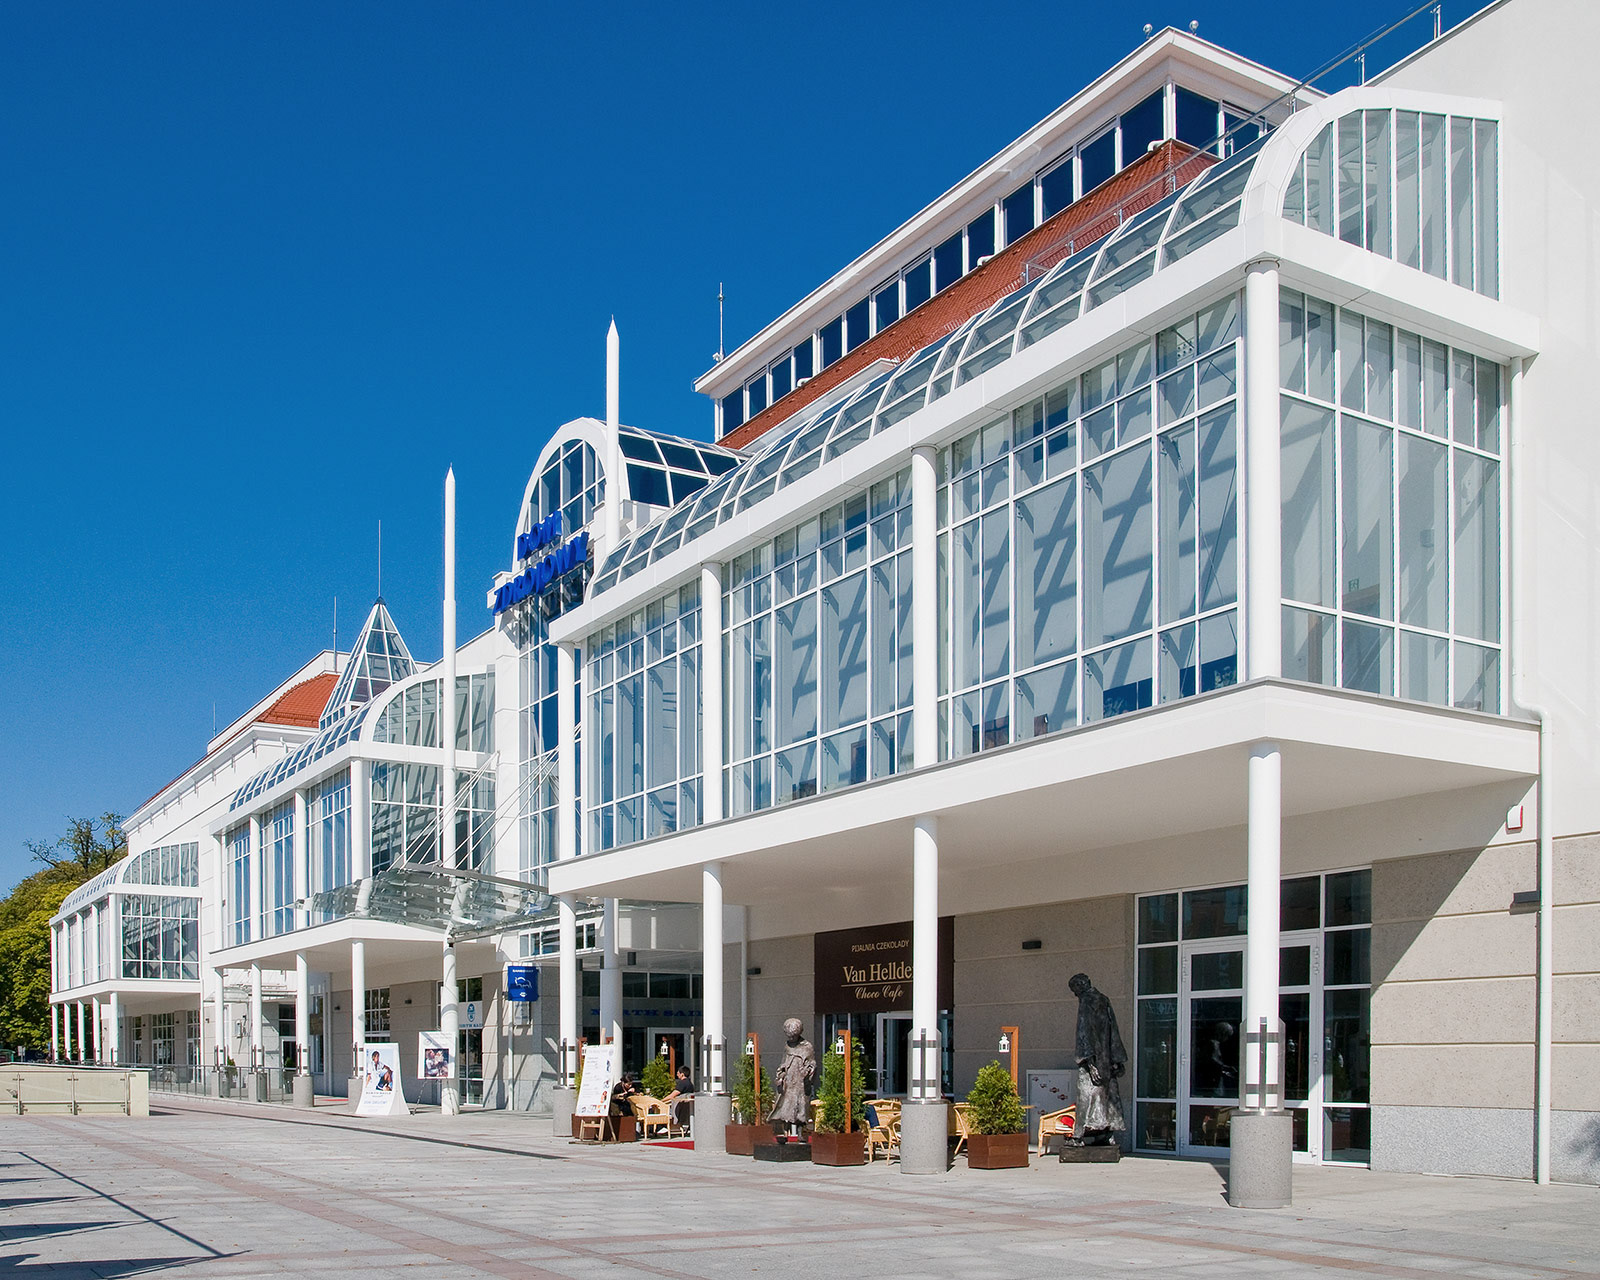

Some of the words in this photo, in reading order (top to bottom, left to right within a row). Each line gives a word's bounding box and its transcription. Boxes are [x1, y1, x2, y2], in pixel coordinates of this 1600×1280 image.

[851, 943, 876, 953] PIJALNIA
[876, 939, 910, 951] CZEKOLADY
[842, 965, 866, 983] Van
[854, 986, 880, 1000] Choco
[881, 984, 904, 1003] Cafe
